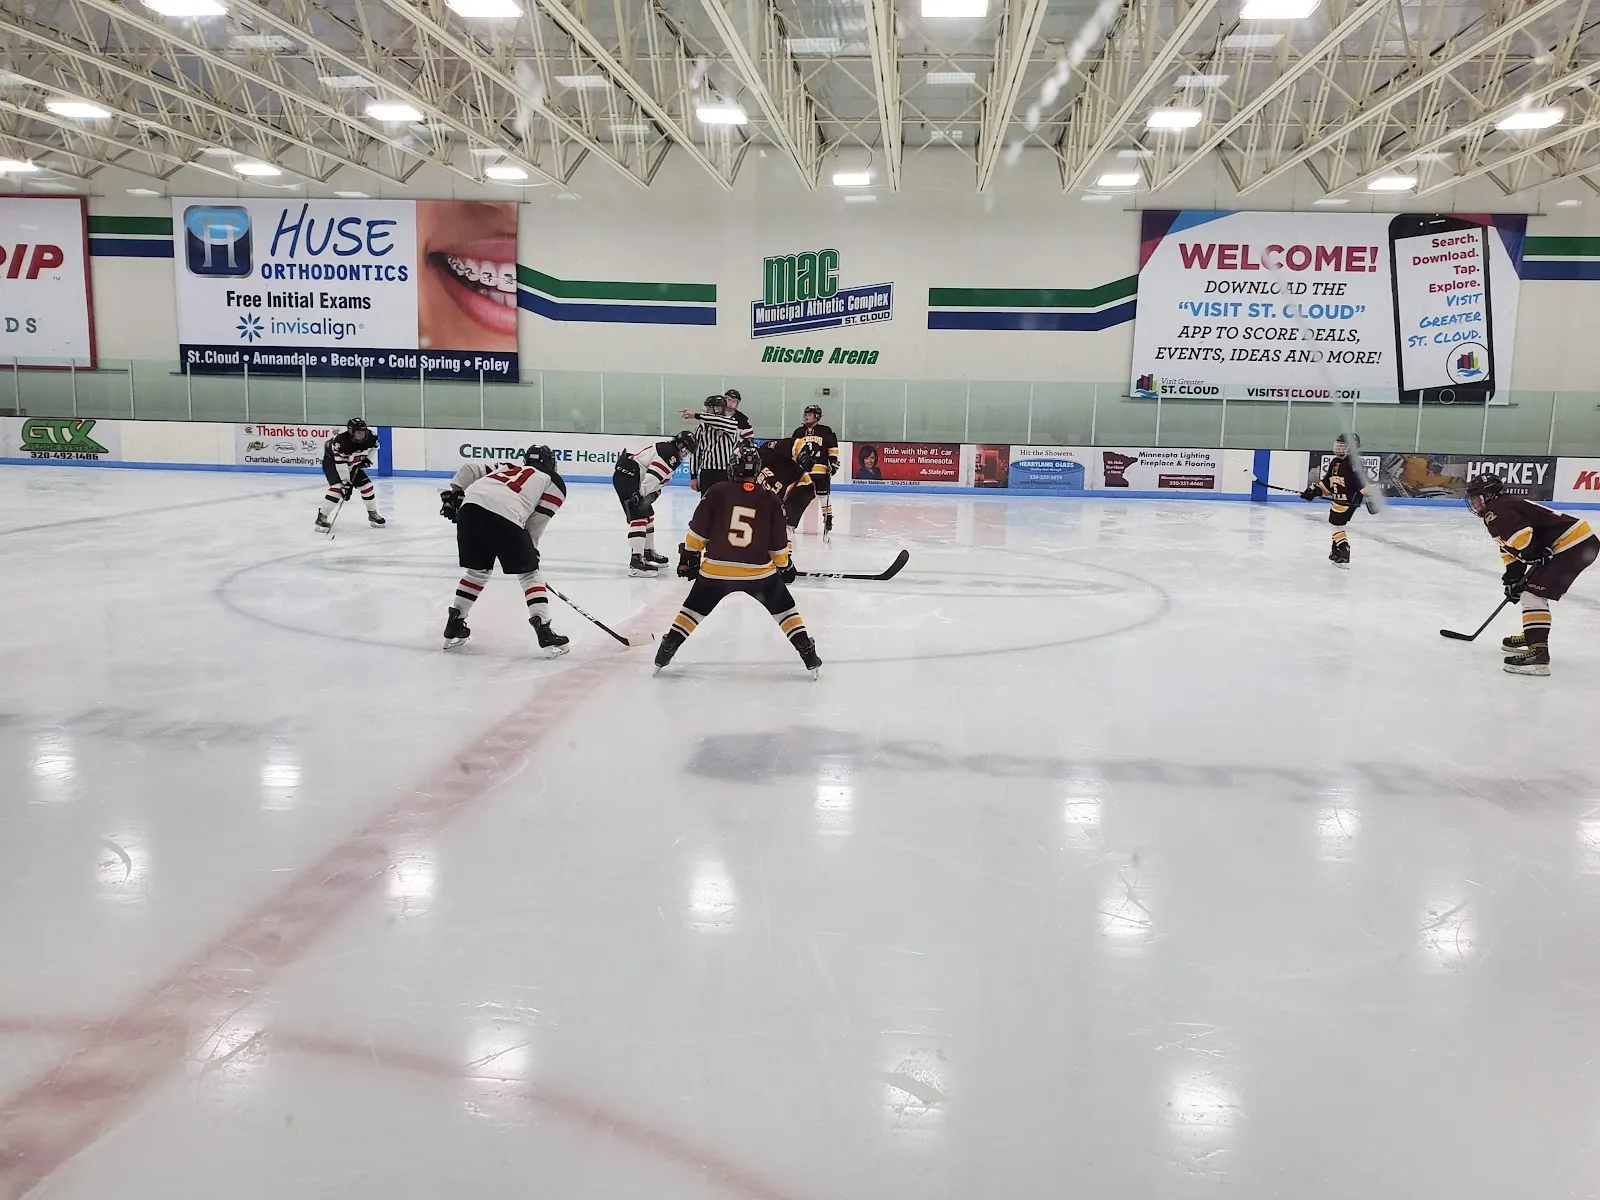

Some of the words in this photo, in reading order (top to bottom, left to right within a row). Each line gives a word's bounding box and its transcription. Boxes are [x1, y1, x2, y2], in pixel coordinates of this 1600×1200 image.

[270, 203, 397, 258] HUSE
[1432, 233, 1479, 248] Search.
[0, 243, 64, 280] IP
[1178, 243, 1379, 273] WELCOME!
[1412, 248, 1479, 266] Download.
[261, 263, 409, 281] ORTHODONTICS
[764, 249, 840, 306] mac
[1453, 264, 1480, 275] Tap.
[1204, 281, 1307, 296] DOWNLOAD
[1312, 282, 1347, 296] THE
[1429, 278, 1481, 294] Explore.
[226, 290, 262, 308] Free
[267, 291, 314, 309] Initial
[319, 293, 371, 310] Exams
[755, 304, 804, 324] Municipal
[806, 298, 845, 317] Athletic
[847, 291, 889, 312] Complex
[1446, 293, 1483, 307] VISIT
[844, 316, 857, 325] ST.
[859, 311, 890, 323] CLOUD
[1248, 303, 1276, 318] ST.
[1419, 311, 1482, 329] GREATER
[1178, 325, 1212, 339] APP
[1216, 326, 1239, 340] TO
[1243, 327, 1299, 341] SCORE
[1302, 328, 1361, 344] DEALS,
[1408, 335, 1428, 348] ST.
[1433, 329, 1482, 344] CLOUD.
[252, 352, 318, 366] Annandale
[331, 352, 375, 368] Becker
[388, 354, 417, 369] Cold
[420, 355, 460, 372] Spring
[474, 357, 510, 374] Foley
[761, 346, 824, 364] Ritsche
[828, 347, 879, 365] Arena
[1155, 347, 1226, 364] EVENTS,
[1229, 348, 1282, 362] IDEAS
[1284, 349, 1324, 363] AND
[1327, 350, 1382, 365] MORE!
[1160, 385, 1177, 394] ST.
[1178, 386, 1219, 395] CLOUD
[1161, 377, 1177, 385] Visit
[1178, 378, 1204, 386] Greater
[21, 418, 98, 446] GTX
[256, 425, 294, 437] Thanks
[297, 426, 309, 438] to
[311, 429, 329, 438] our
[244, 455, 280, 464] Charitable
[280, 456, 314, 466] Gambling
[459, 443, 573, 463] CENTRARE
[883, 447, 899, 455] Ride
[917, 448, 928, 456] the
[929, 448, 938, 456] #1
[1138, 451, 1178, 459] Minnesota
[1180, 452, 1211, 460] Lighting
[917, 457, 955, 465] Minnesota.
[1140, 459, 1174, 468] Fireplace
[1184, 461, 1216, 469] Flooring
[486, 462, 536, 494] 21
[615, 465, 636, 477] CCM
[1466, 461, 1549, 485] HOCKEY
[727, 505, 757, 548] 5
